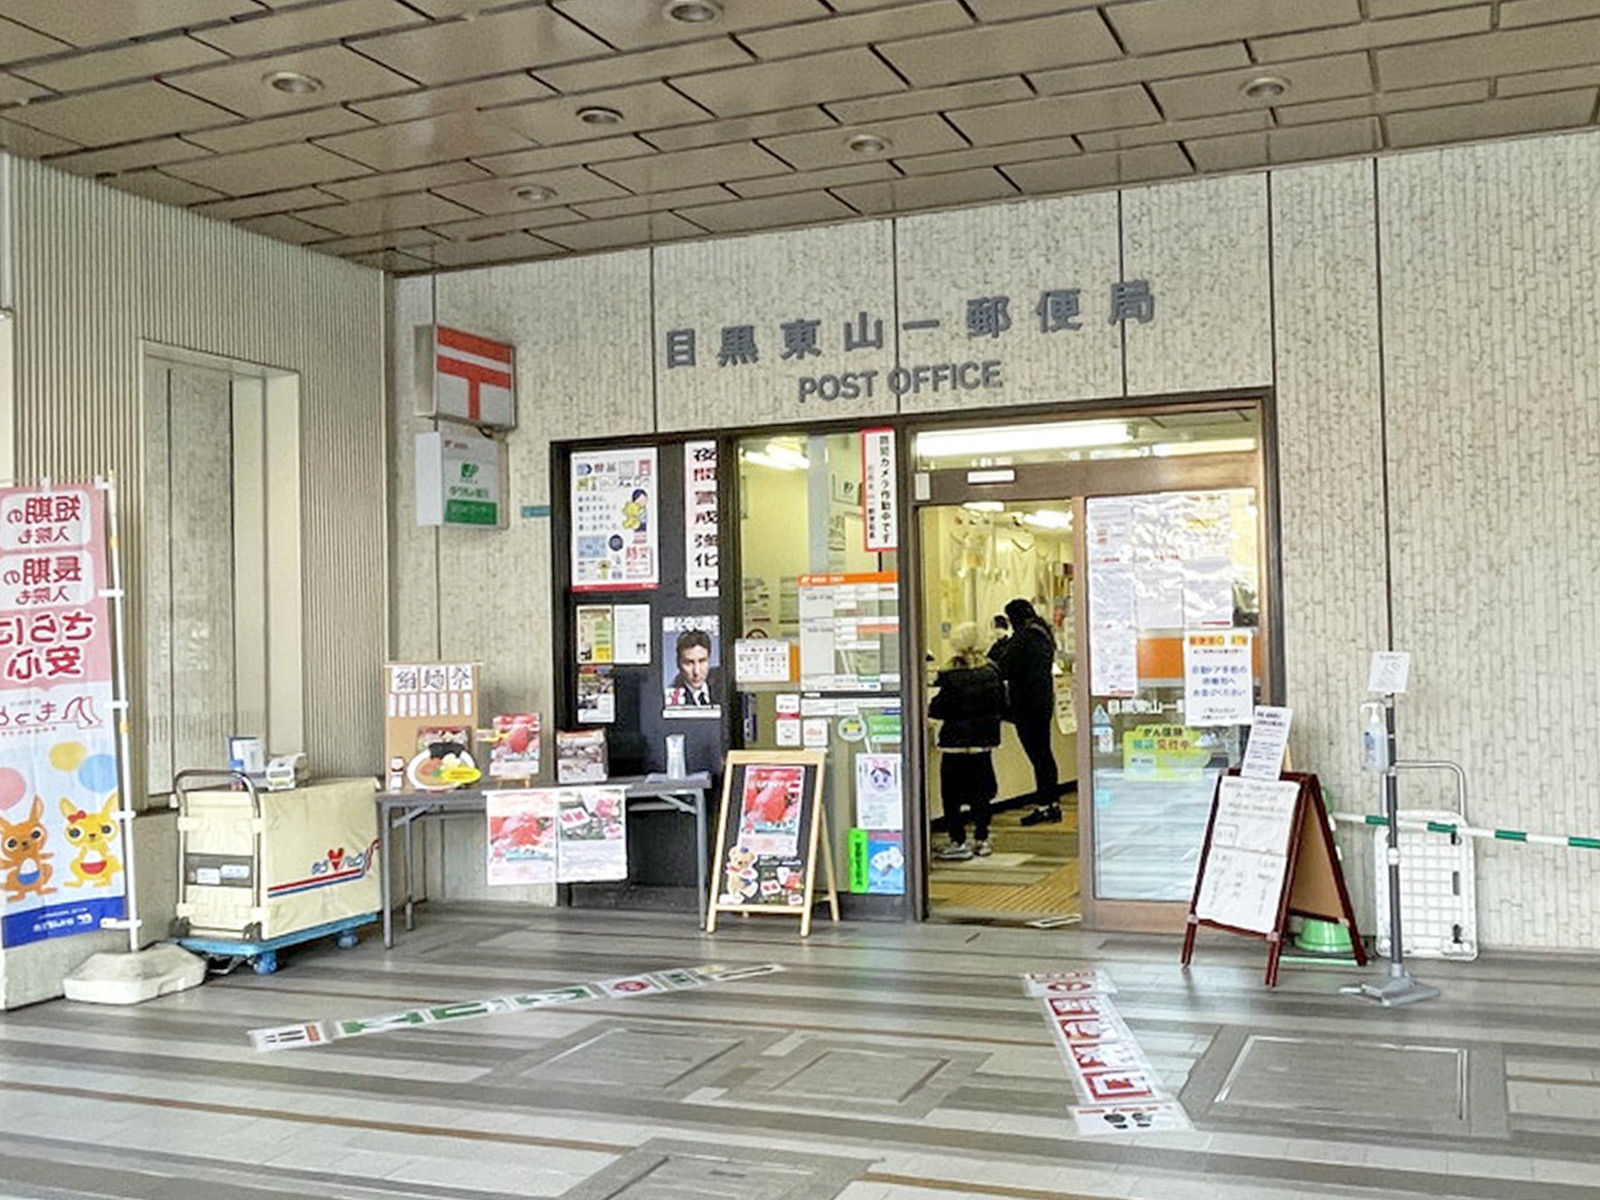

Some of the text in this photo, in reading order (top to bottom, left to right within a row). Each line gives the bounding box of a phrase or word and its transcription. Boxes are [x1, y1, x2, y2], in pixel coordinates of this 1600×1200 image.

[665, 279, 1156, 368] 目黒東山一郵便局
[798, 360, 1004, 403] POST OFFICE
